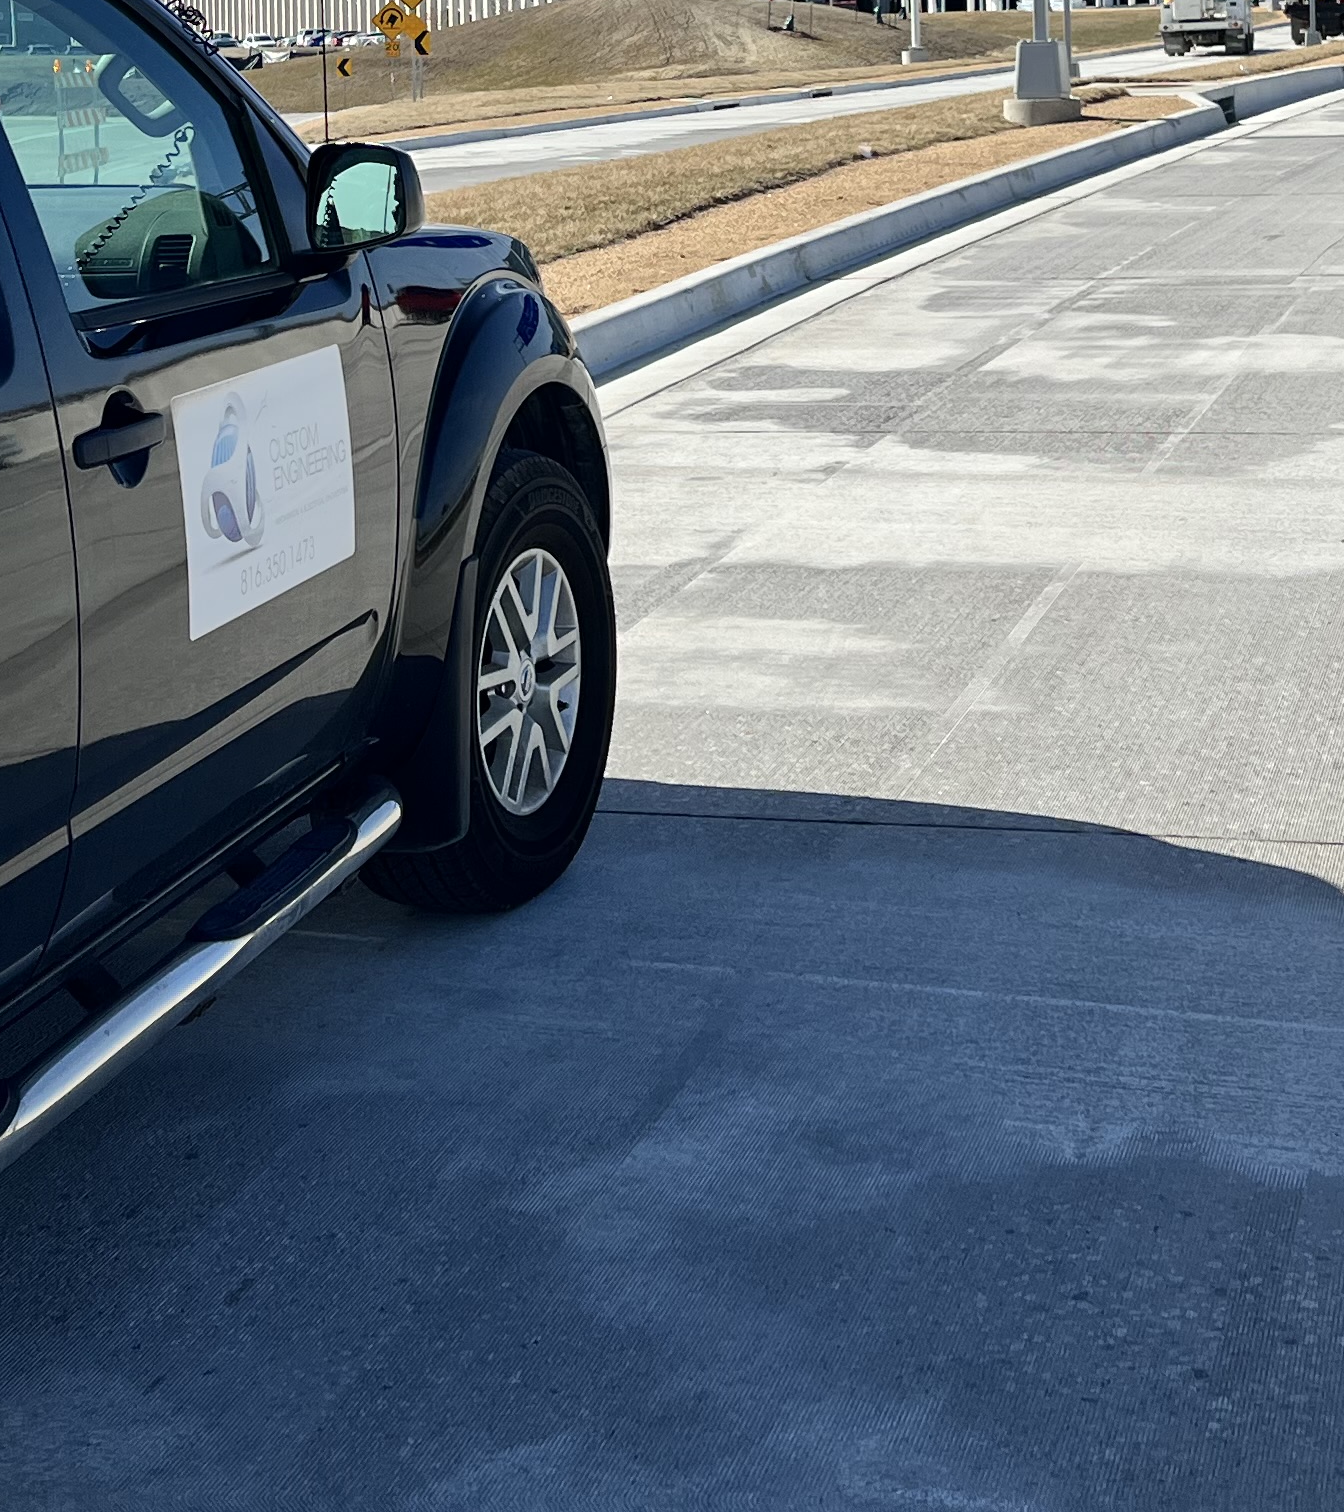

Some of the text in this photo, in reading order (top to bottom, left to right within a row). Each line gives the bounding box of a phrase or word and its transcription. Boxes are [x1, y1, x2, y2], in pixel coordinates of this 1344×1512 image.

[385, 42, 399, 51] 20
[269, 422, 320, 464] CUSTOM
[273, 439, 347, 492] ENGINEERING
